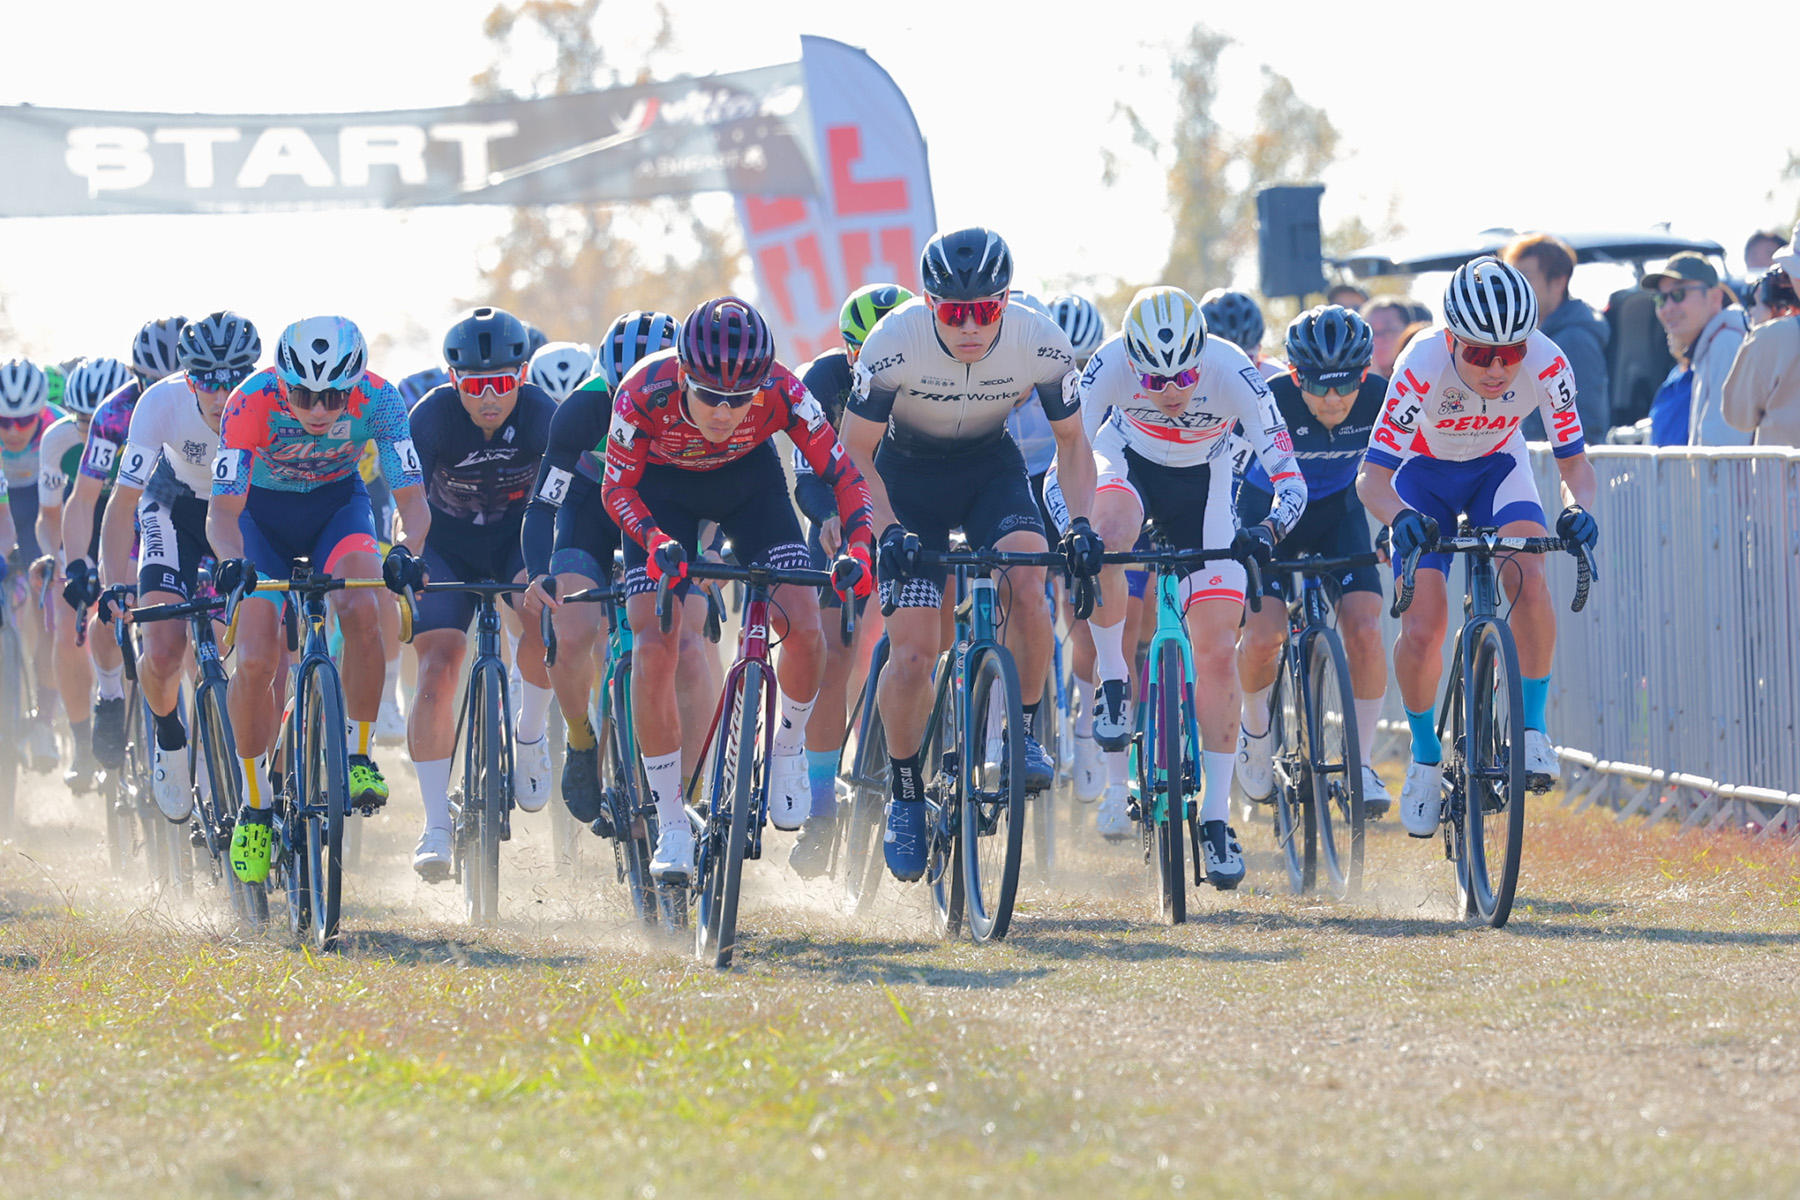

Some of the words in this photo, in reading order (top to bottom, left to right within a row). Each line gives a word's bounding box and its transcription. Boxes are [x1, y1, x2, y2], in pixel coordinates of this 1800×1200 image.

[64, 121, 518, 198] START
[868, 353, 906, 374] サンエース
[1037, 346, 1073, 367] サンエース
[1319, 371, 1350, 381] GIANT
[1558, 379, 1571, 404] 5
[1268, 404, 1279, 426] 1
[1400, 405, 1421, 425] 5
[615, 428, 626, 445] 4
[92, 446, 113, 467] 13
[129, 454, 144, 474] 9
[407, 448, 416, 470] 6
[216, 457, 228, 479] 6
[549, 478, 565, 500] 3
